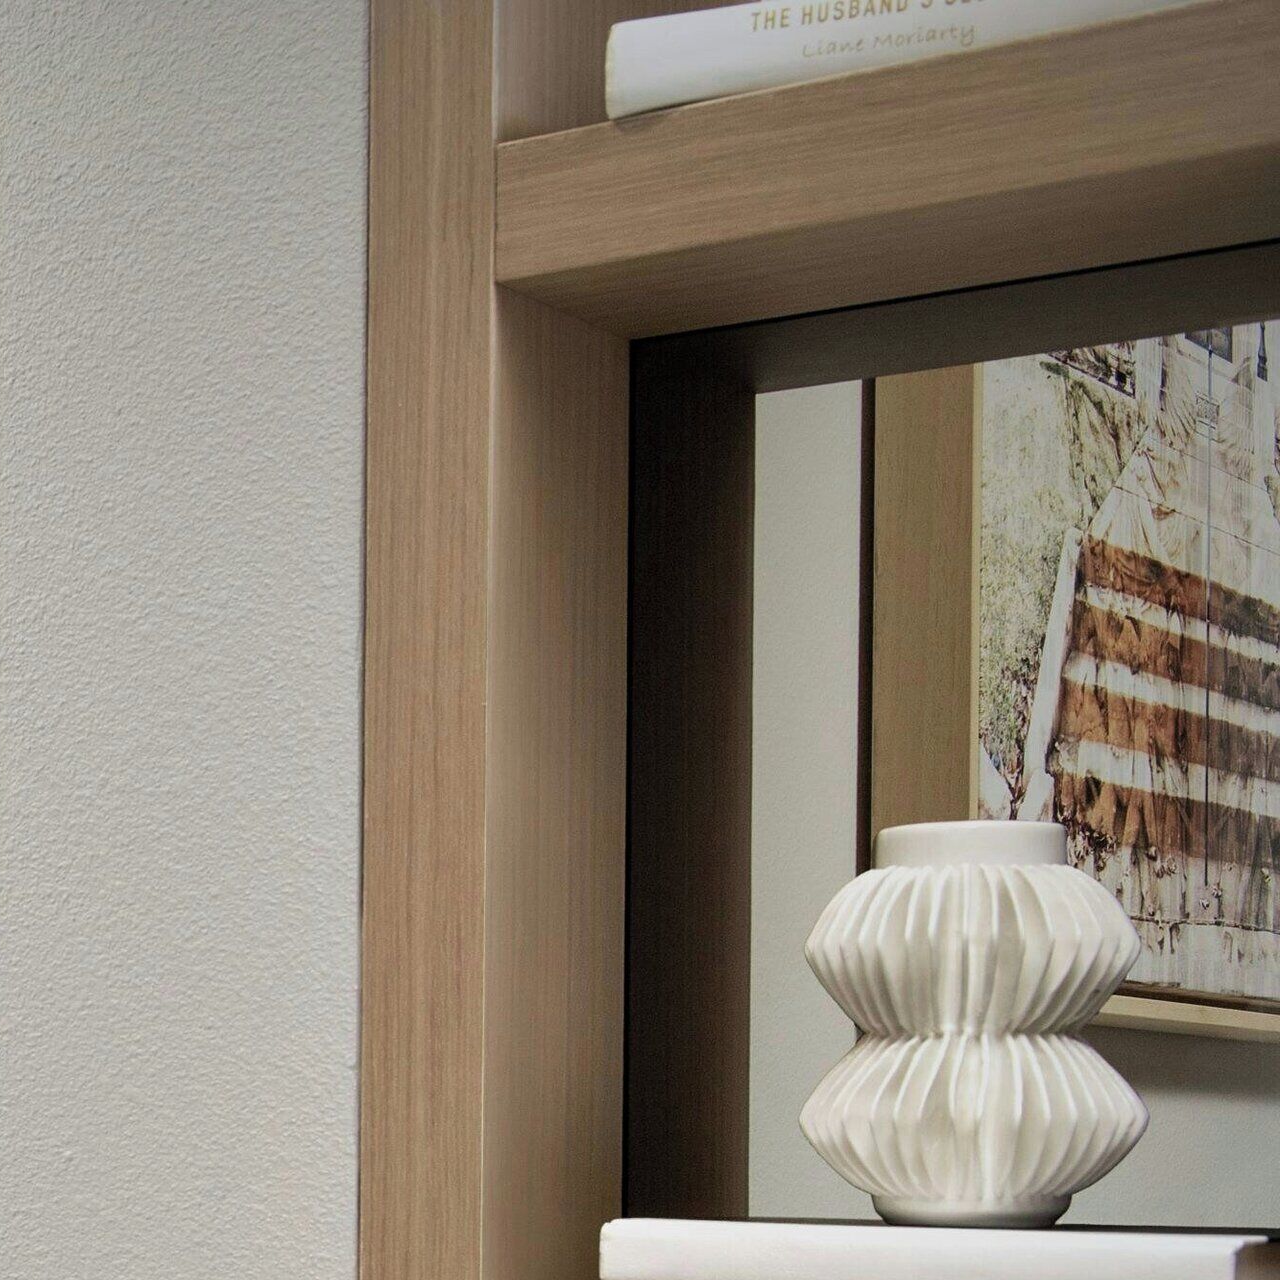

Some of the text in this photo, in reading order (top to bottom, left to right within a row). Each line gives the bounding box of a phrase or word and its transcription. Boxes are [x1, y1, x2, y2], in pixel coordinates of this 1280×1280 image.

[751, 0, 931, 32] THE HUSBAND
[802, 24, 975, 58] Liane Moriarty
